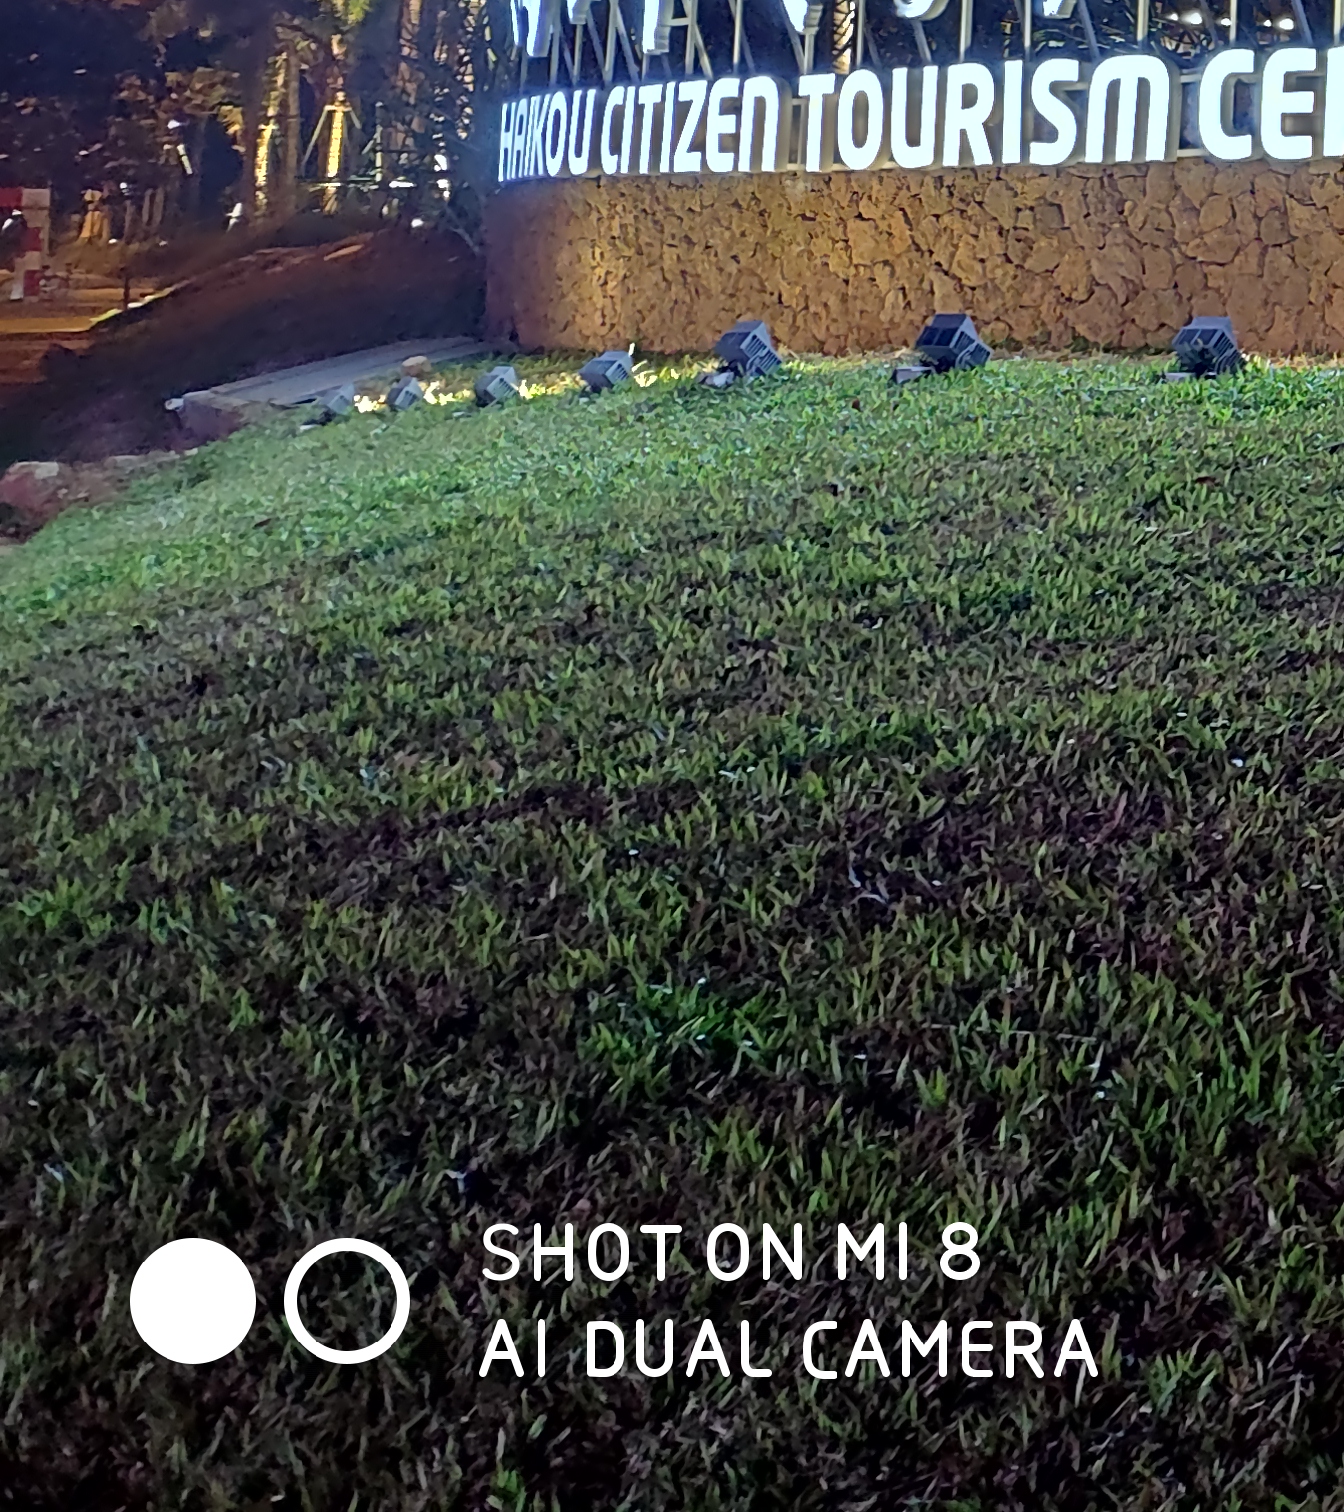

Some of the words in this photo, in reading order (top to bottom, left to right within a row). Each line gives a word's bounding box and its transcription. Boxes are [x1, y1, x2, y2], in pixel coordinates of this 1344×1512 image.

[497, 85, 598, 183] HAIKOU
[600, 74, 780, 176] CITIZEN
[797, 53, 1171, 174] TOURISM
